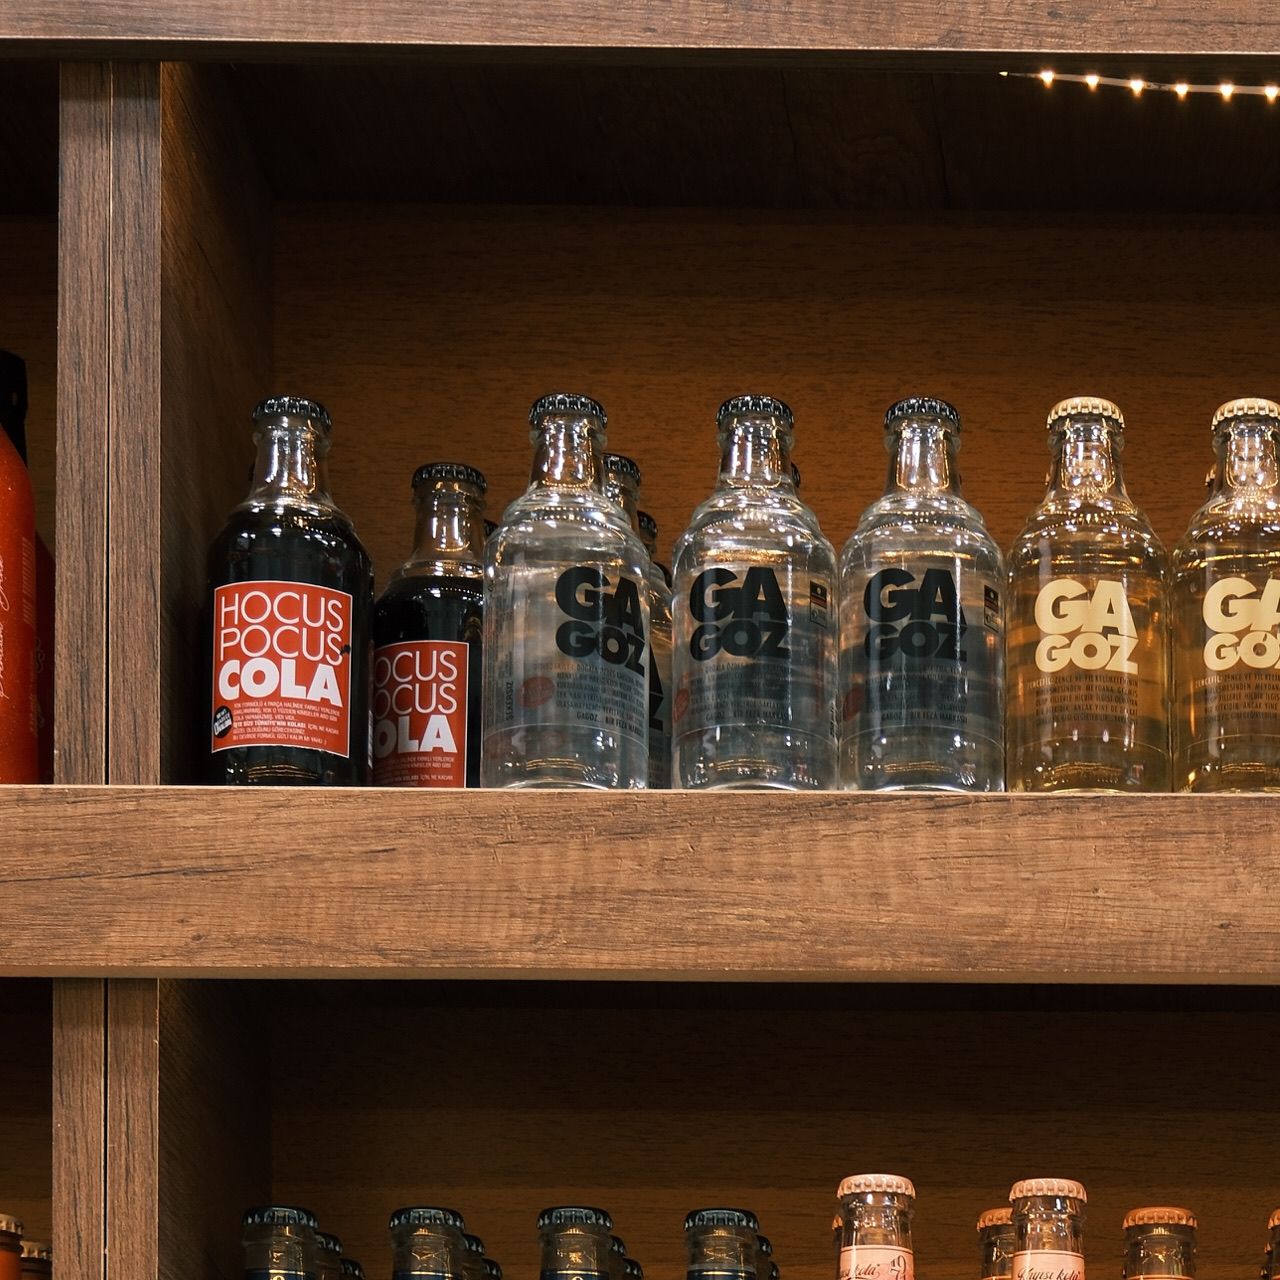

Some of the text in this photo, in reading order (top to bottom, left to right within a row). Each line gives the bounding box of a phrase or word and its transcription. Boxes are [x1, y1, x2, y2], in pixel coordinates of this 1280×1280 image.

[221, 591, 343, 632] HOCUS
[555, 566, 645, 638] GA
[690, 567, 790, 622] GA
[1035, 578, 1137, 638] GA
[221, 625, 343, 665] POCUS
[556, 620, 645, 677] GOZ
[690, 619, 790, 661] GOZ
[1035, 632, 1138, 674] GOZ
[219, 658, 342, 707] COLA
[375, 651, 457, 688] OCUS
[375, 683, 457, 719] OCUS
[374, 715, 457, 758] OLA
